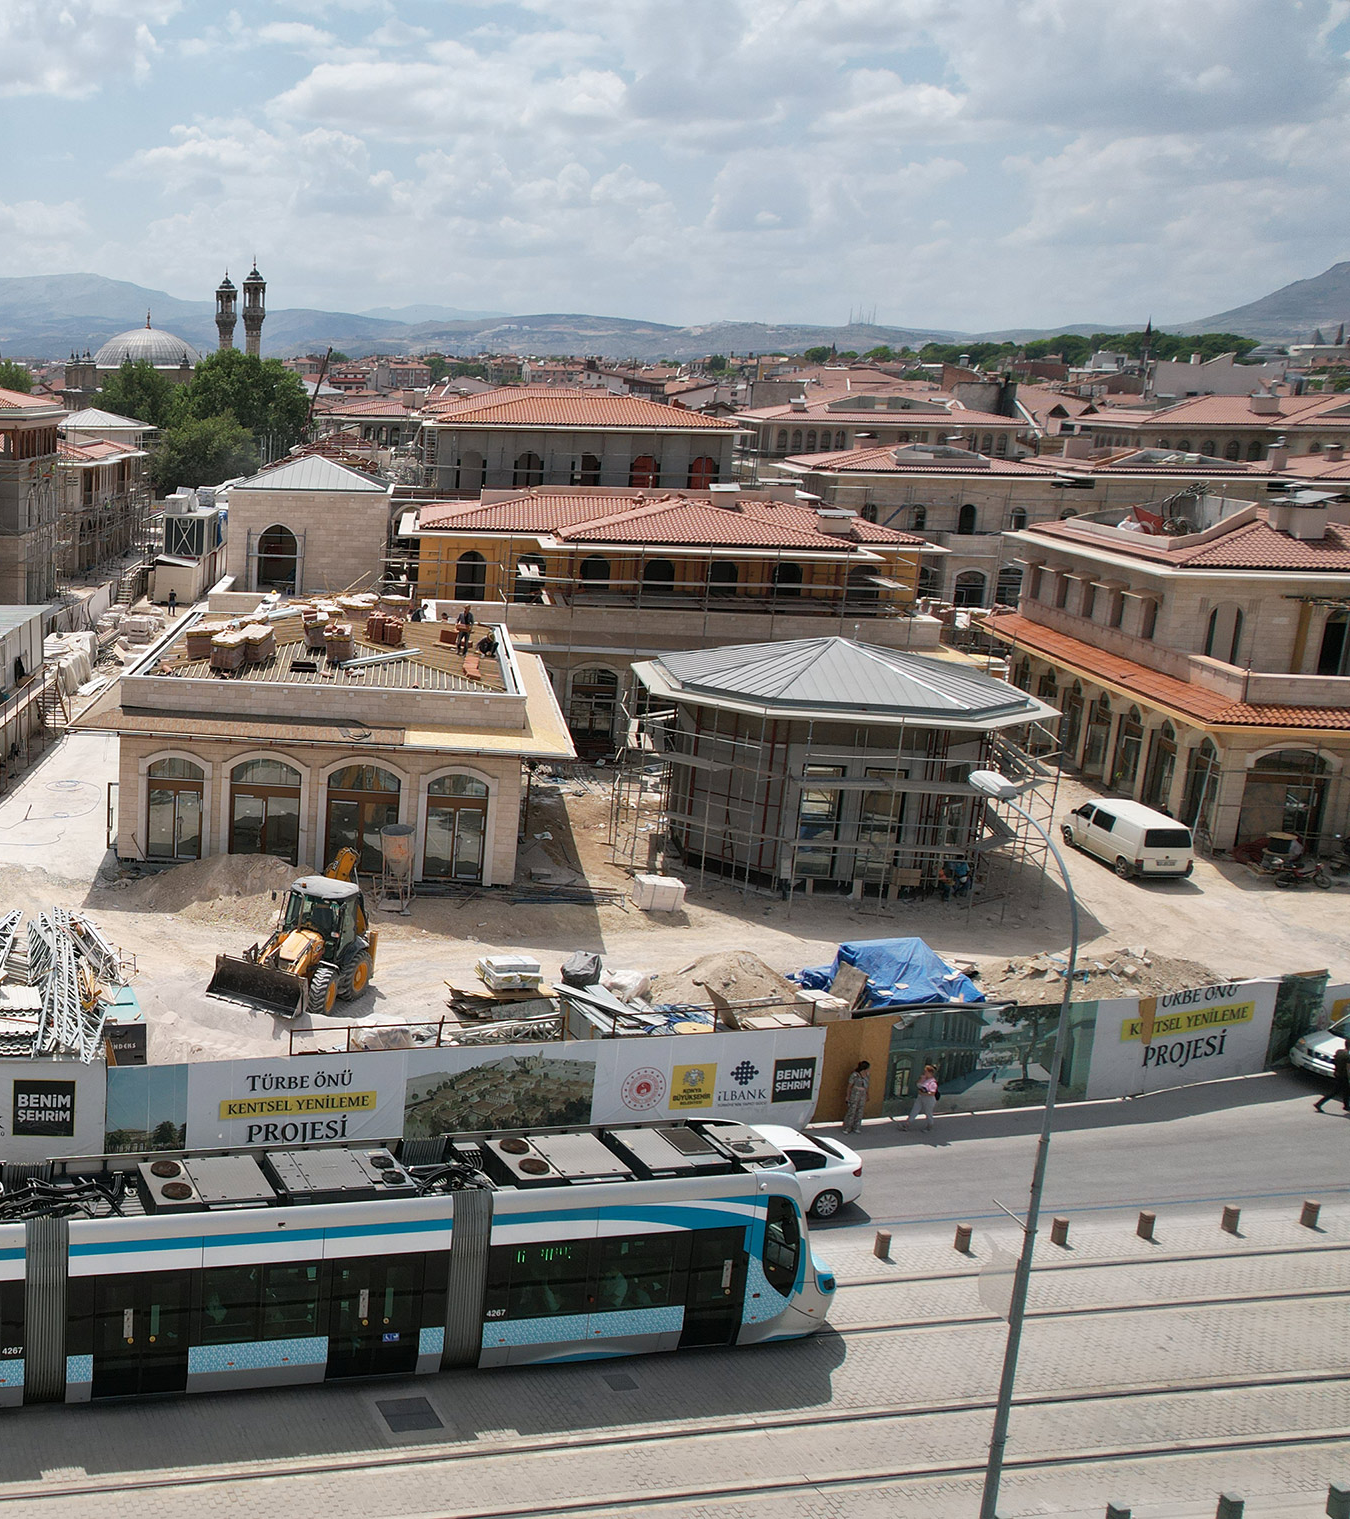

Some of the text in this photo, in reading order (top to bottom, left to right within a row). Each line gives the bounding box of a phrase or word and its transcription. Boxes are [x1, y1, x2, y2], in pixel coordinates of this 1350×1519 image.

[1130, 1006, 1249, 1036] KTSEL YENİLEME
[1142, 1028, 1227, 1068] PROJESİ
[246, 1069, 353, 1092] TÜRBE ÖNÜ
[228, 1095, 370, 1115] KENTSEL YENİLEME
[246, 1114, 348, 1143] PROJESİ
[486, 1308, 506, 1317] 4267
[1, 1346, 24, 1355] 4267
